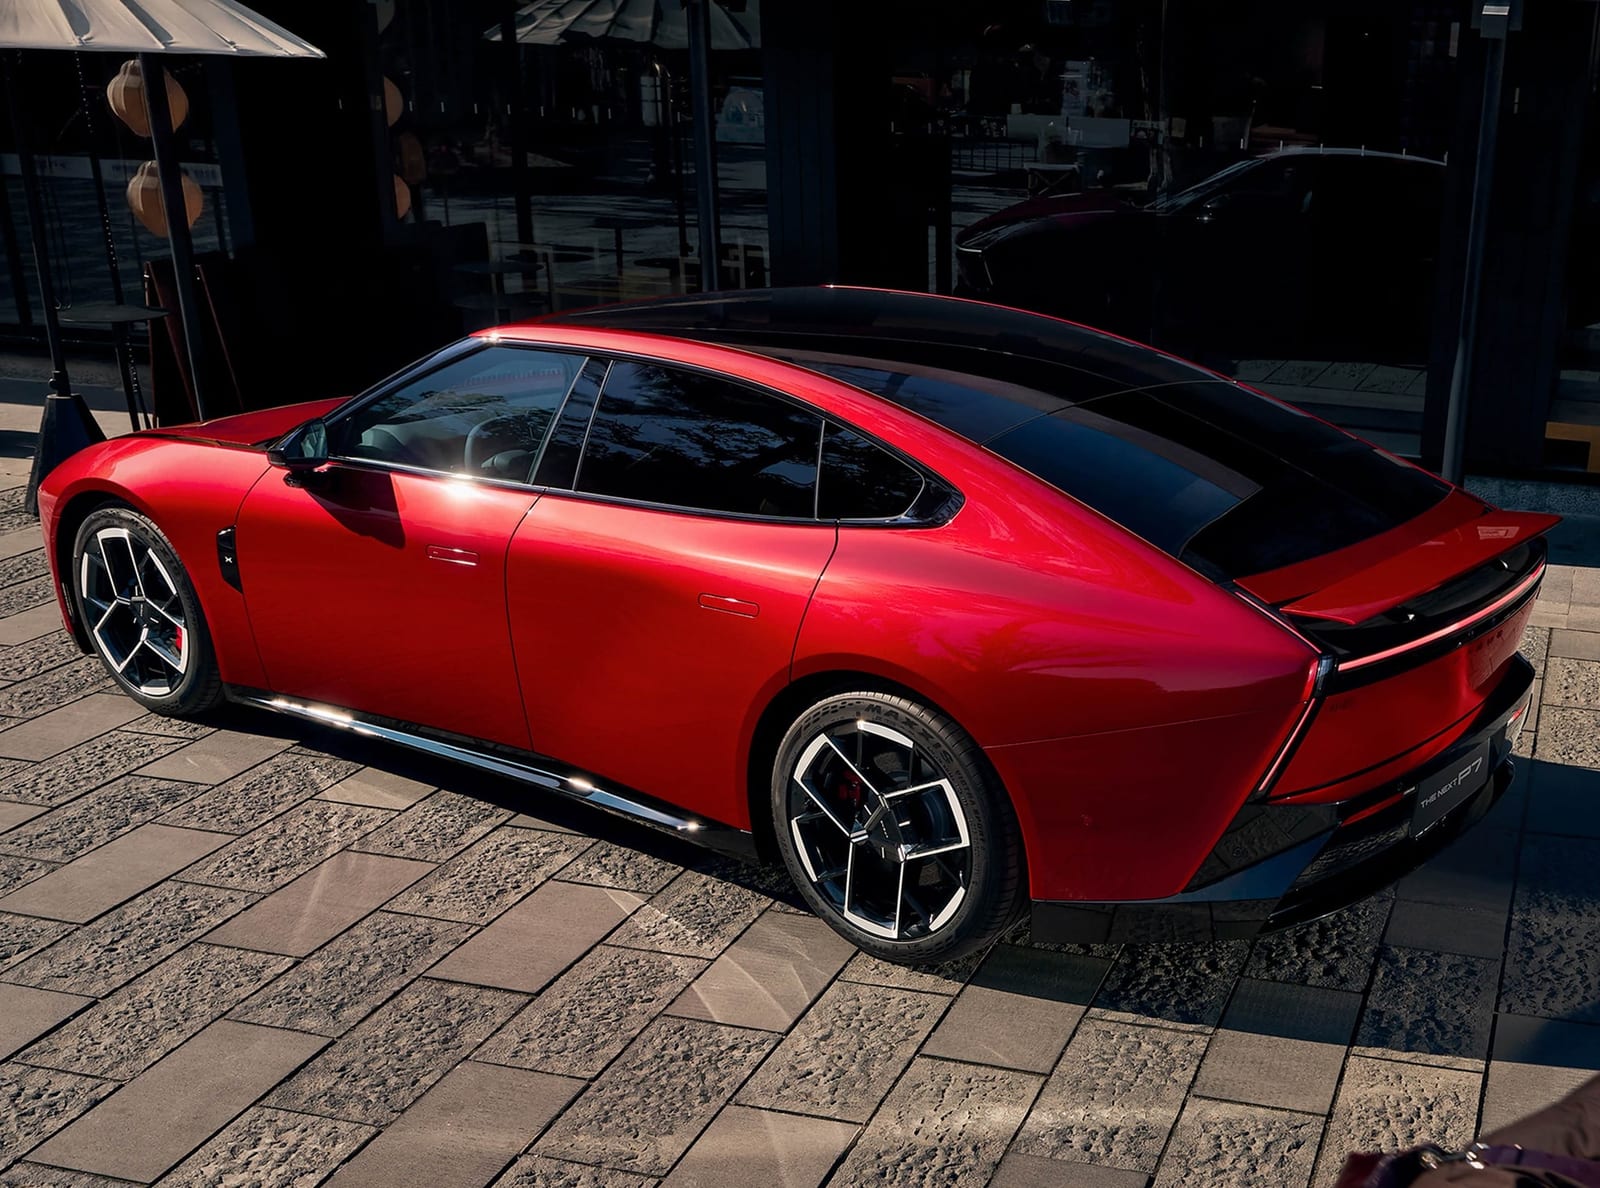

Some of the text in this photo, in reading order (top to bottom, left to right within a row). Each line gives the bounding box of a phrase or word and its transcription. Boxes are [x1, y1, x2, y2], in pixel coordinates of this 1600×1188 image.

[864, 703, 953, 764] MAXXIS
[1420, 756, 1483, 808] THE NEXT P7
